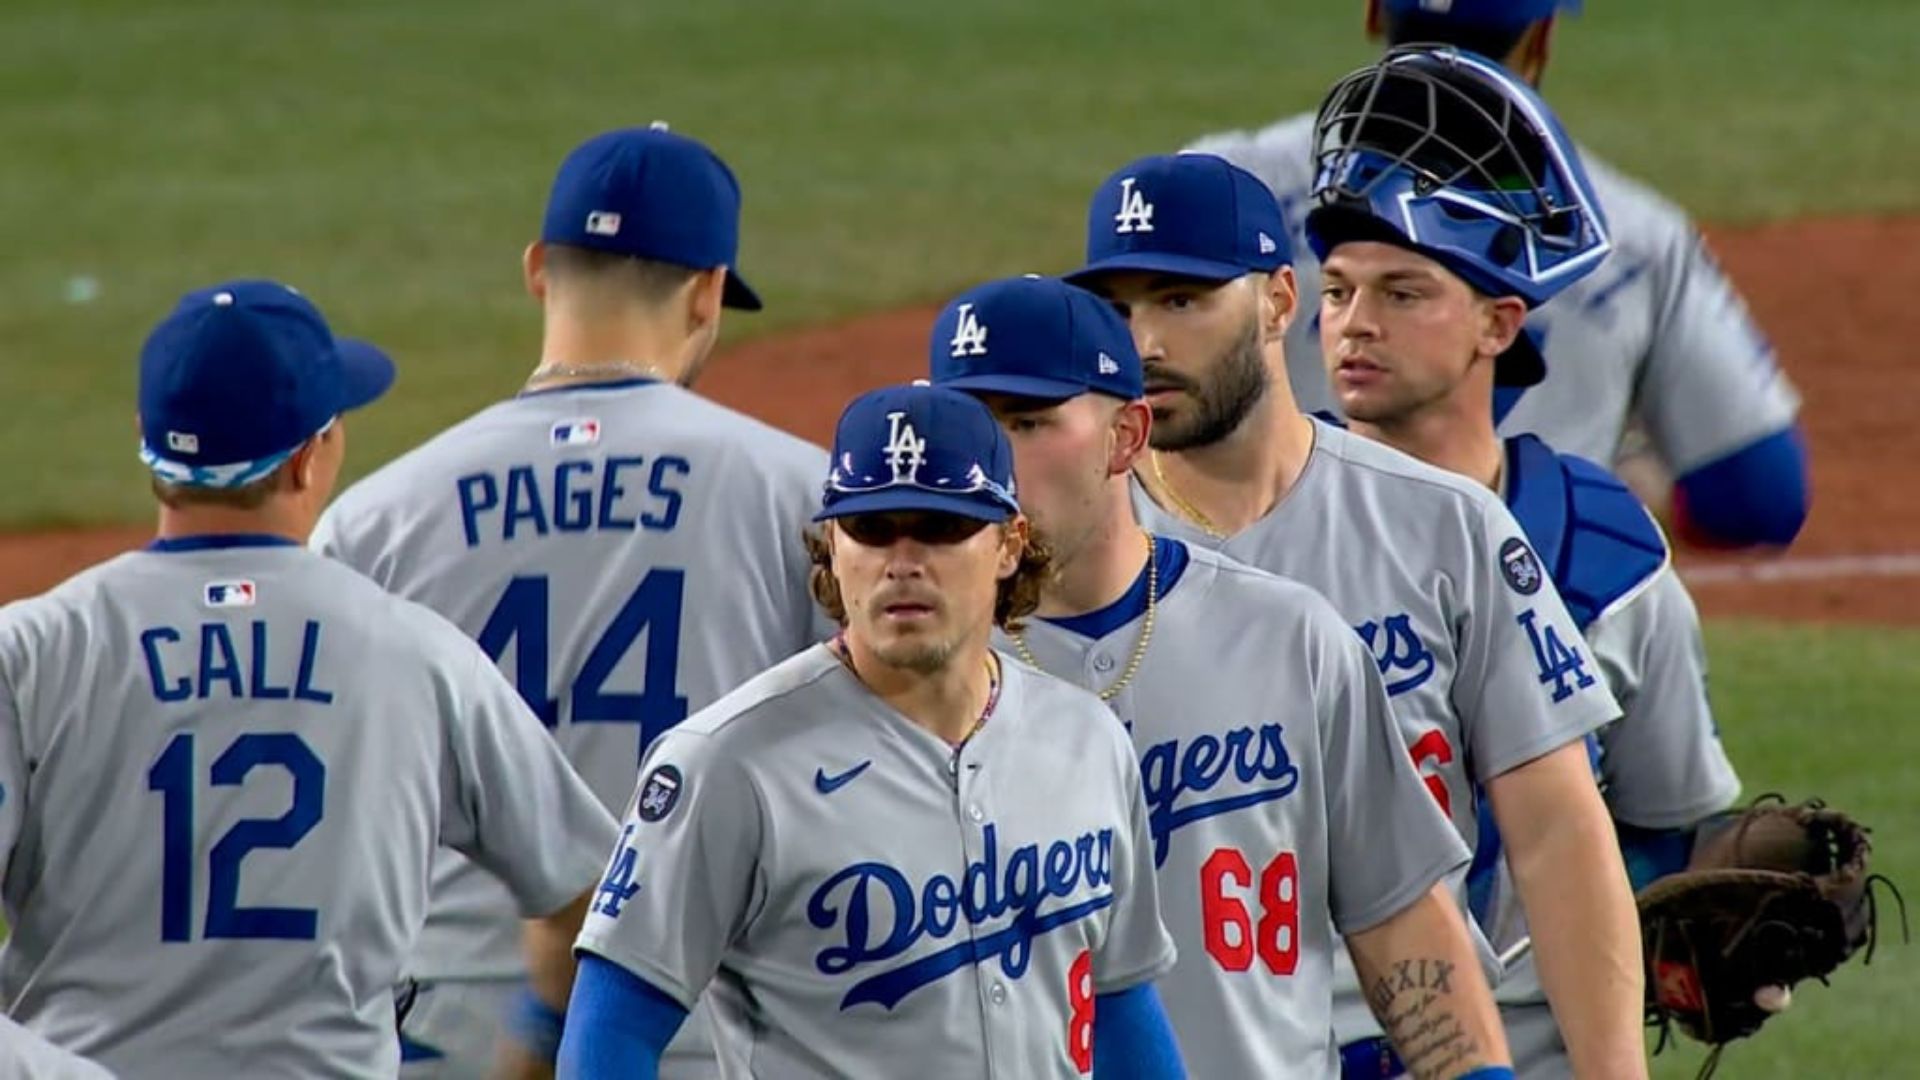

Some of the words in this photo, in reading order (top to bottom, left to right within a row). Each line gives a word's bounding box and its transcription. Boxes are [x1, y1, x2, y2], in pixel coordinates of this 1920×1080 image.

[1115, 177, 1154, 233] LA
[951, 303, 988, 357] LA
[883, 411, 927, 466] LA
[457, 456, 690, 547] PAGES
[140, 620, 333, 704] CALL
[478, 567, 689, 768] 44
[1516, 608, 1595, 703] LA
[148, 732, 326, 943] 12
[1140, 722, 1299, 870] gers
[1200, 847, 1300, 976] 68
